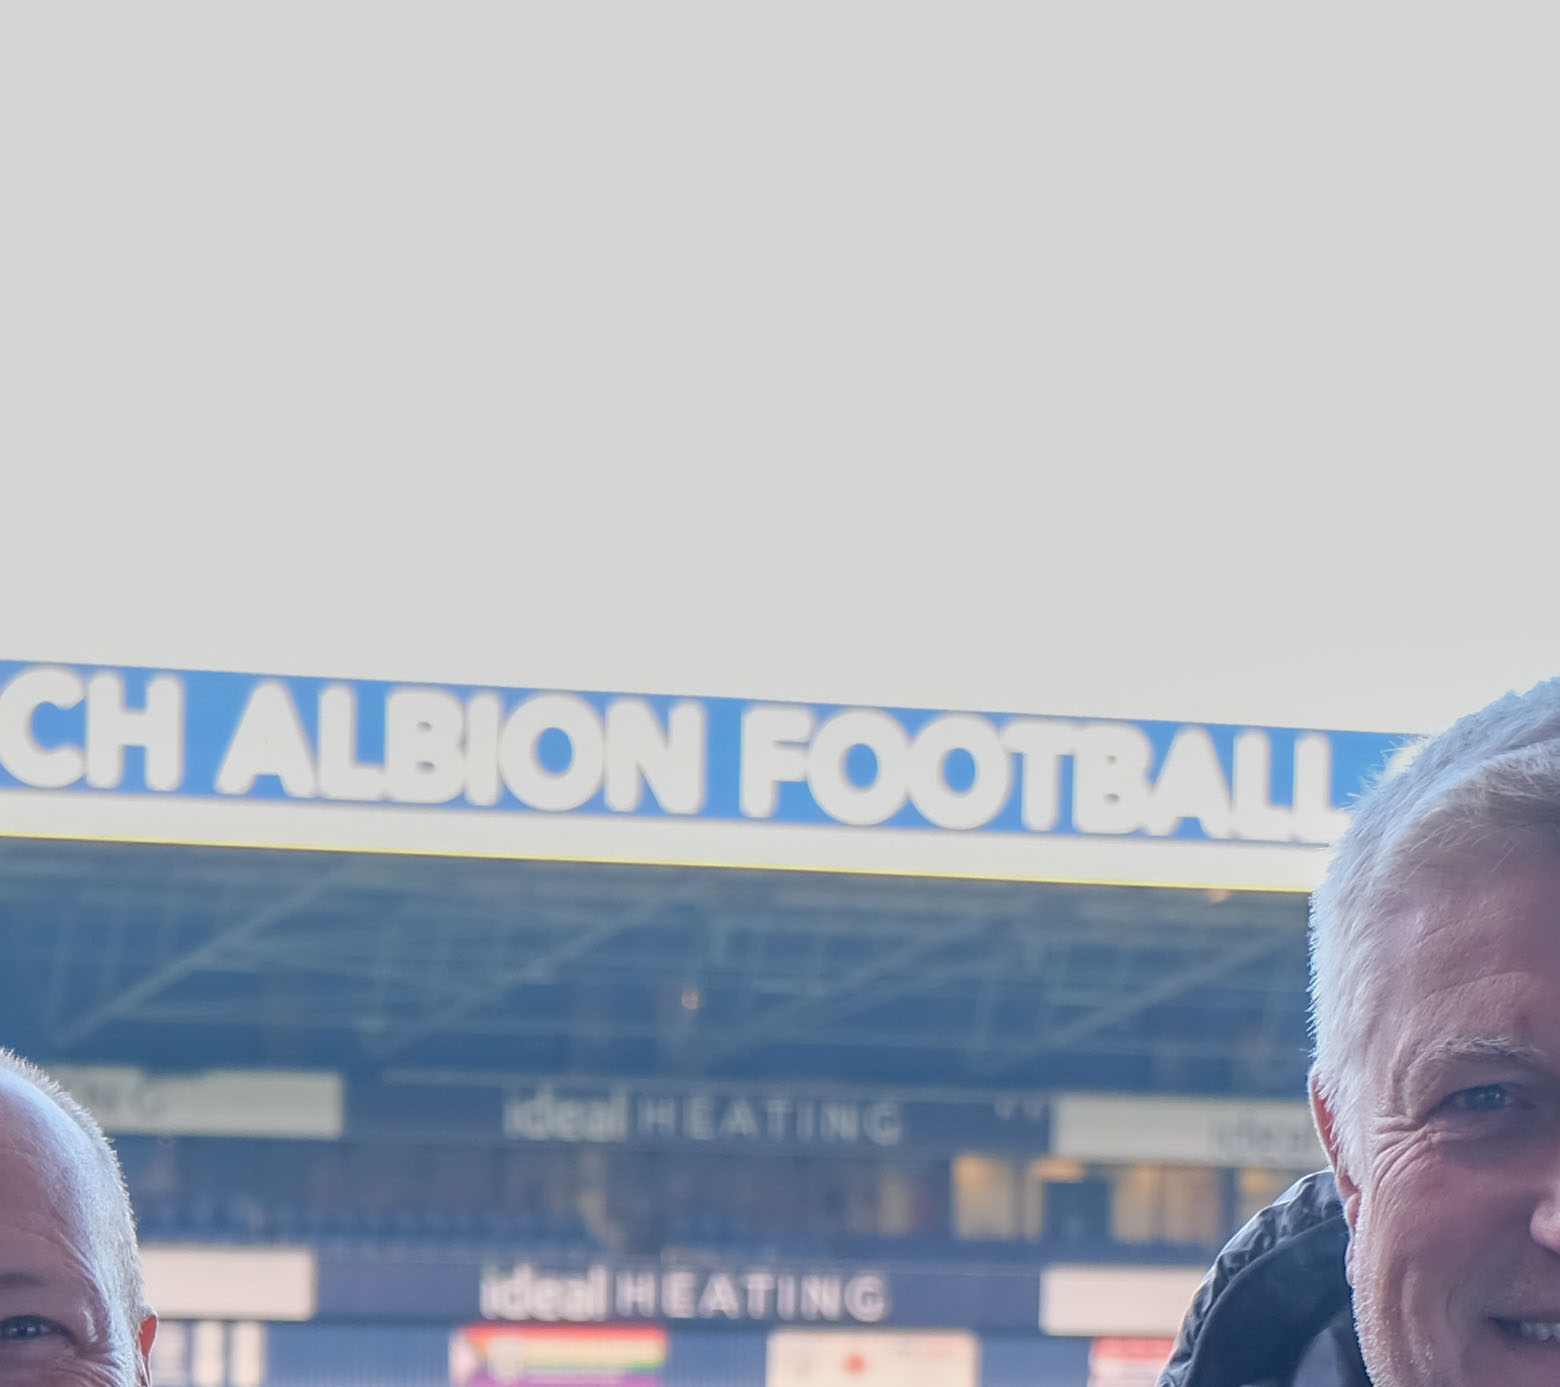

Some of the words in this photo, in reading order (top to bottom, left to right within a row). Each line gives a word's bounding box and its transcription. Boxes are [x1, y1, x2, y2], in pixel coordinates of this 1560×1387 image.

[214, 680, 704, 815] ALBION
[738, 703, 1352, 840] FOOTBALL
[504, 1090, 628, 1142] ideal
[641, 1099, 902, 1145] HEATING
[481, 1264, 610, 1320] ideal
[619, 1272, 887, 1322] HEATING
